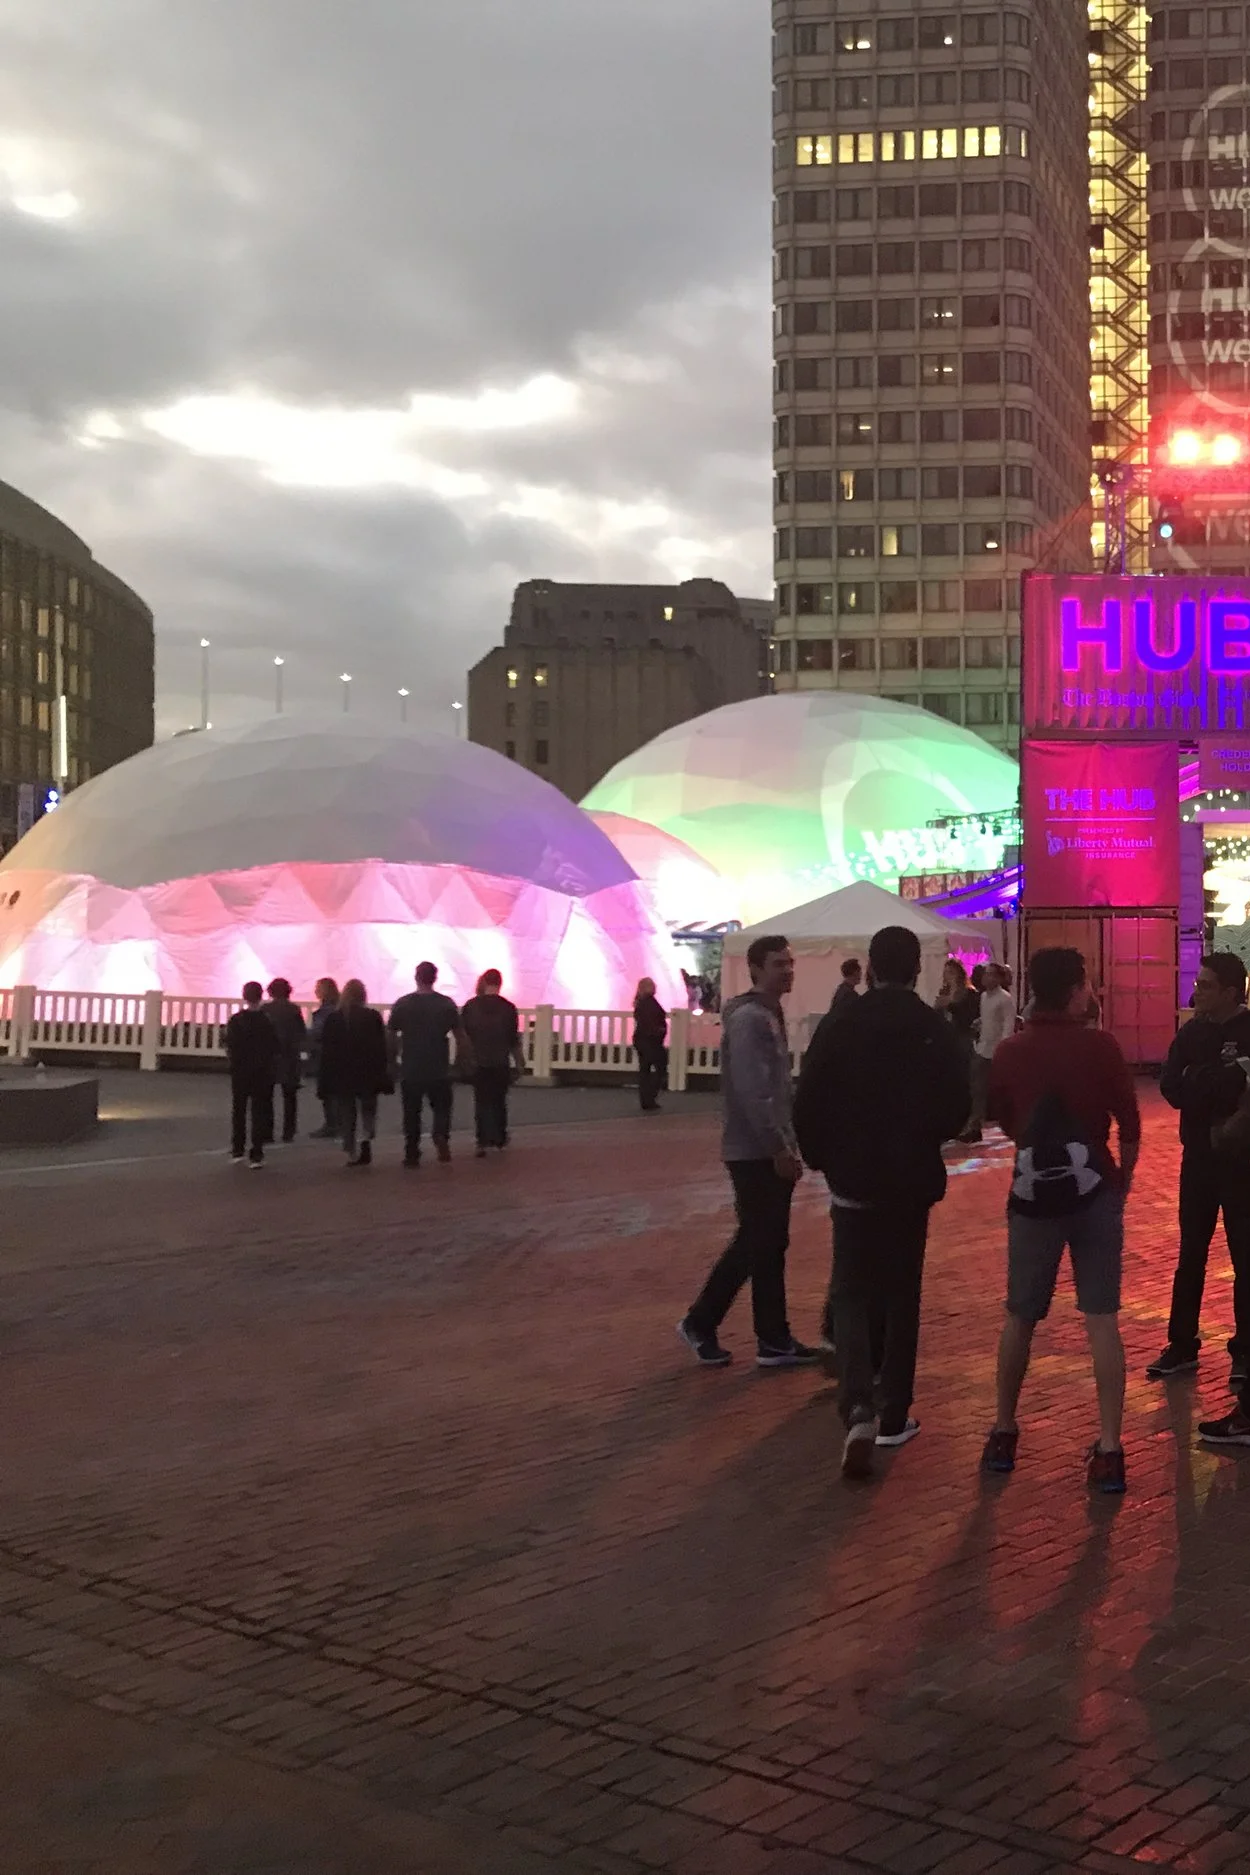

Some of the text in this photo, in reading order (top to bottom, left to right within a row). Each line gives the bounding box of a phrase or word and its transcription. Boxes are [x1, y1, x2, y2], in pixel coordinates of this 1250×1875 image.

[1045, 788, 1157, 811] THE HUB
[1066, 837, 1108, 852] Liberty
